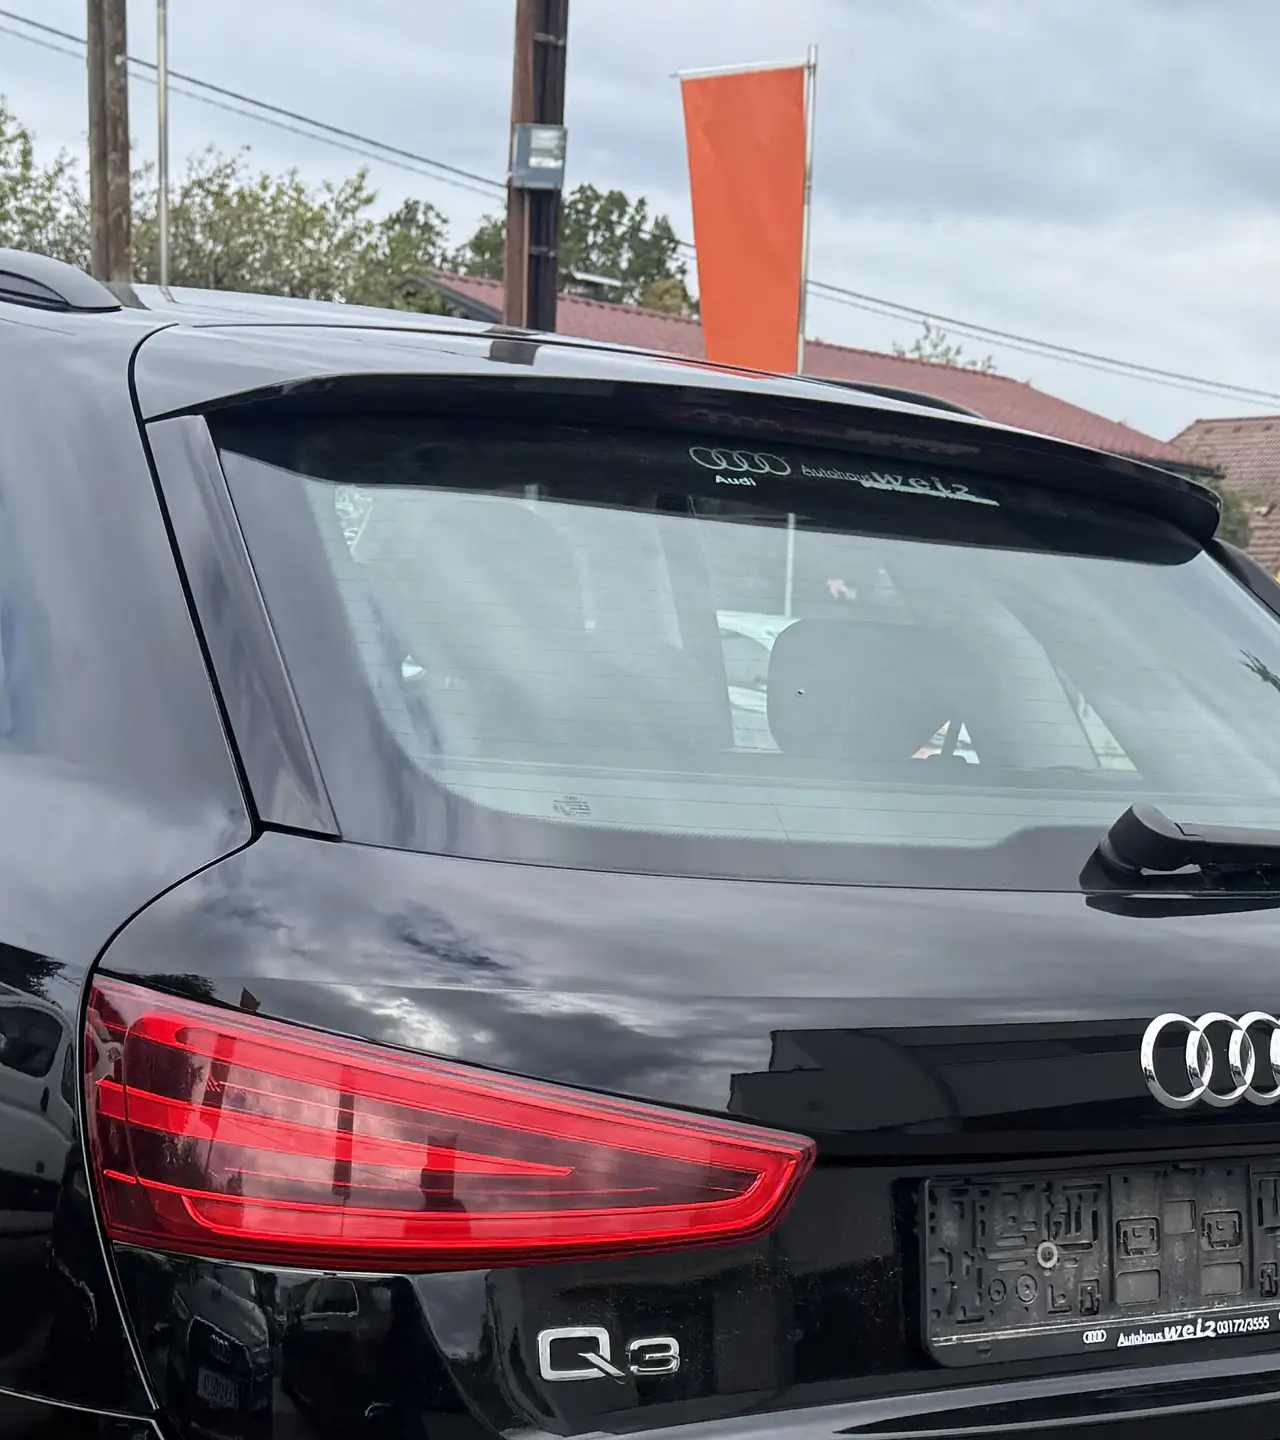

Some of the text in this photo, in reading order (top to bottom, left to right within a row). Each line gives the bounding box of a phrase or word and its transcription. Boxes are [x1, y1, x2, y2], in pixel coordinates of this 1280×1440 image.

[715, 474, 757, 487] Audi
[801, 462, 872, 483] Autohaus
[1117, 1329, 1163, 1347] Autohaus
[1216, 1316, 1270, 1334] 03172/3555
[538, 1326, 681, 1385] Q3
